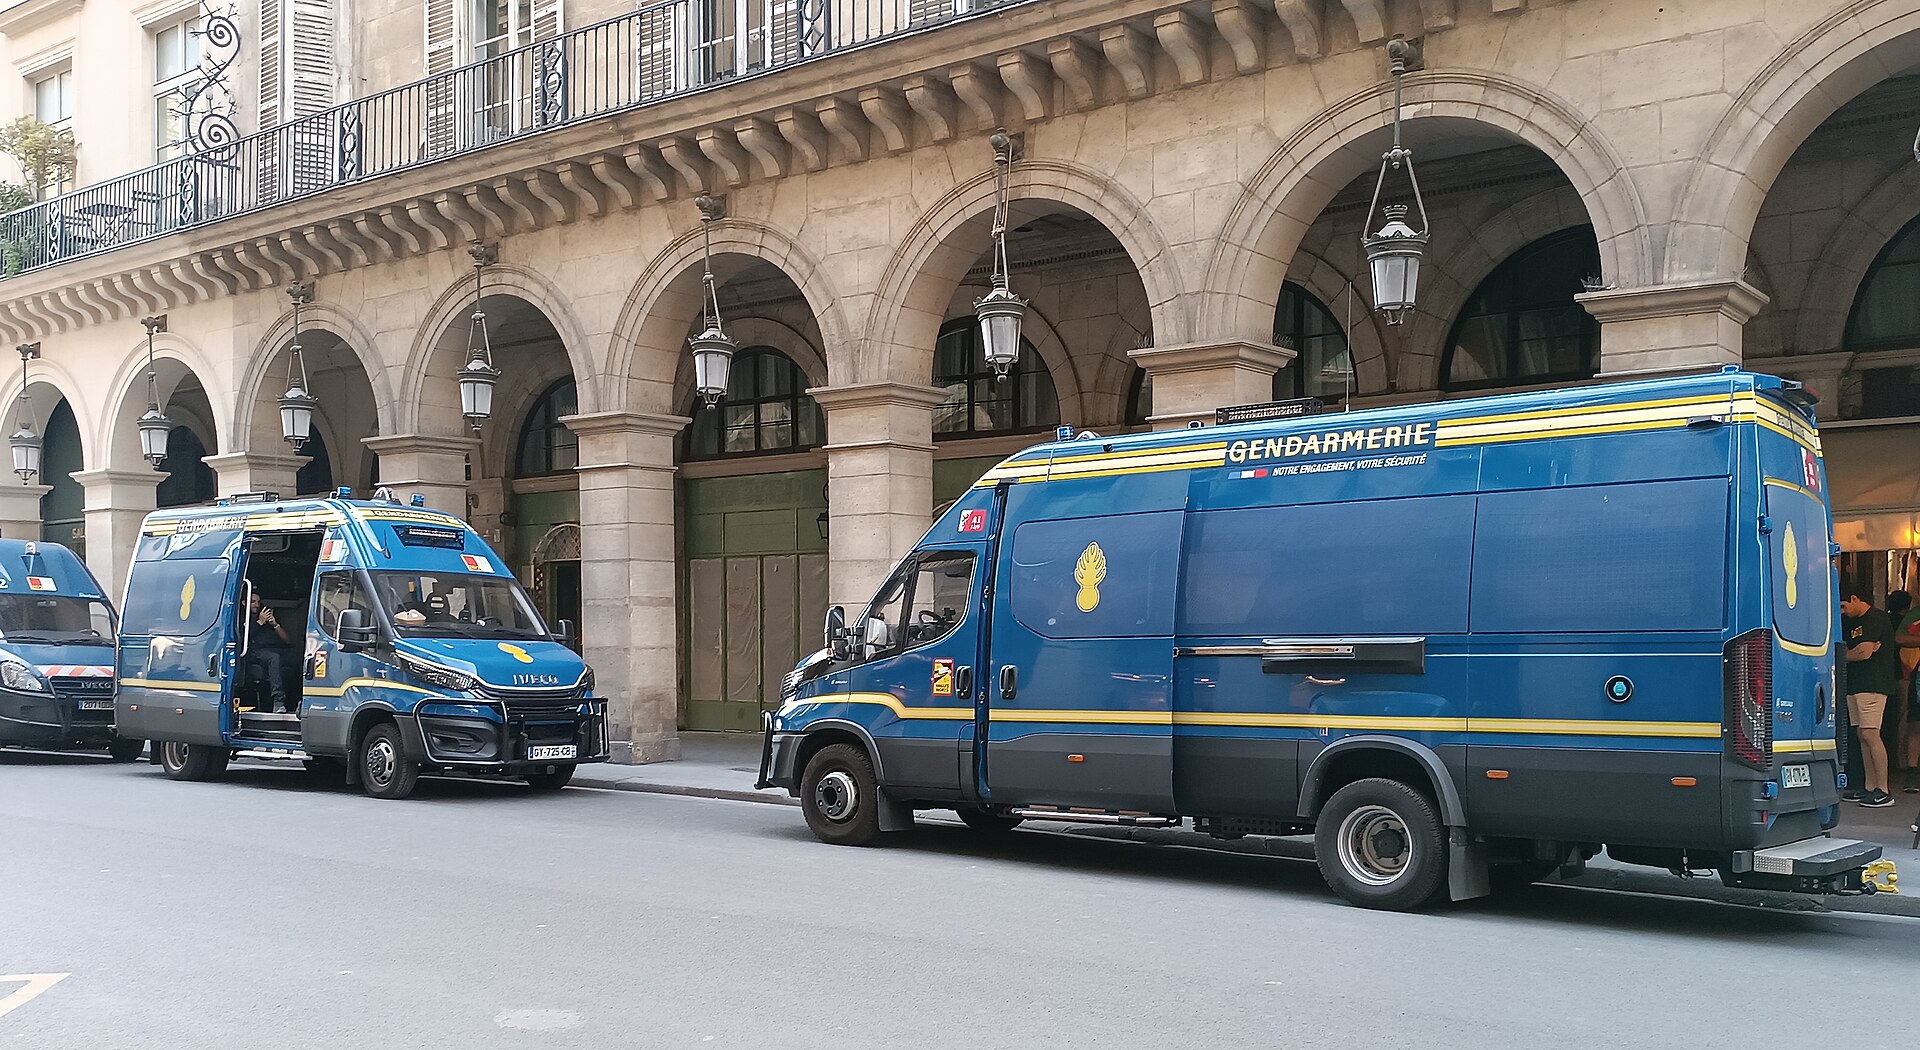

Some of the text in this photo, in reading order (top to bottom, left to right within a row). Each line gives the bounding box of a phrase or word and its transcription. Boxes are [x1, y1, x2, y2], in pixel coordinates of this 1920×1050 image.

[1229, 422, 1431, 463] GENDARMERIE
[1272, 453, 1427, 477] NOTRE ENGAGEMENT, VOTRE SÉCURITÉ
[176, 516, 247, 533] GENDARMERIE
[513, 674, 560, 684] IVECO
